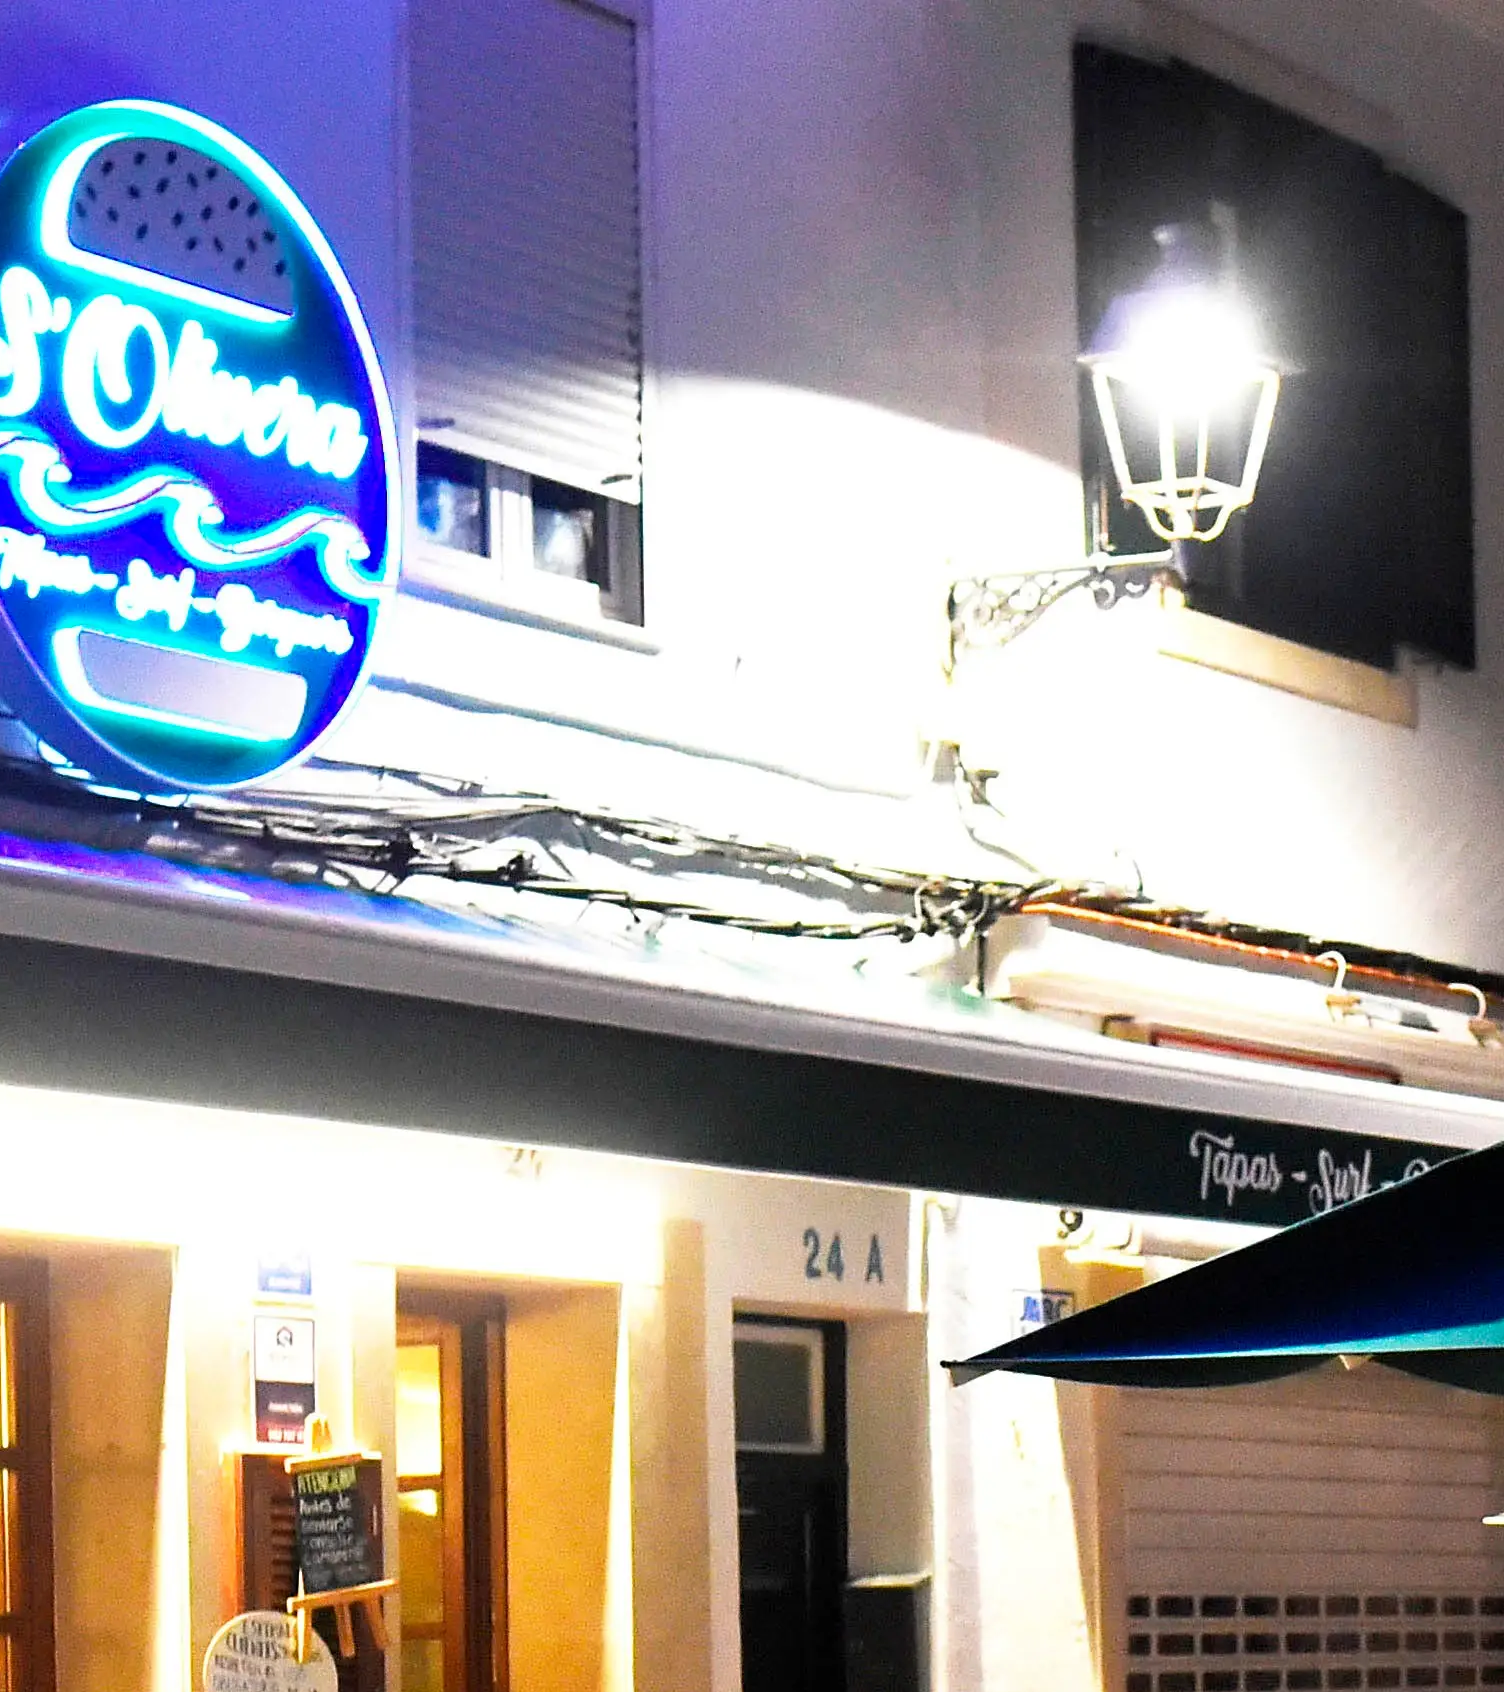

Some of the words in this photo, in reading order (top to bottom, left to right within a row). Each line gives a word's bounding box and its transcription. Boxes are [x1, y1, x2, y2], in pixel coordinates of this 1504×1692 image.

[1189, 1129, 1282, 1207] Tapas
[803, 1226, 845, 1283] 24
[865, 1233, 885, 1284] A
